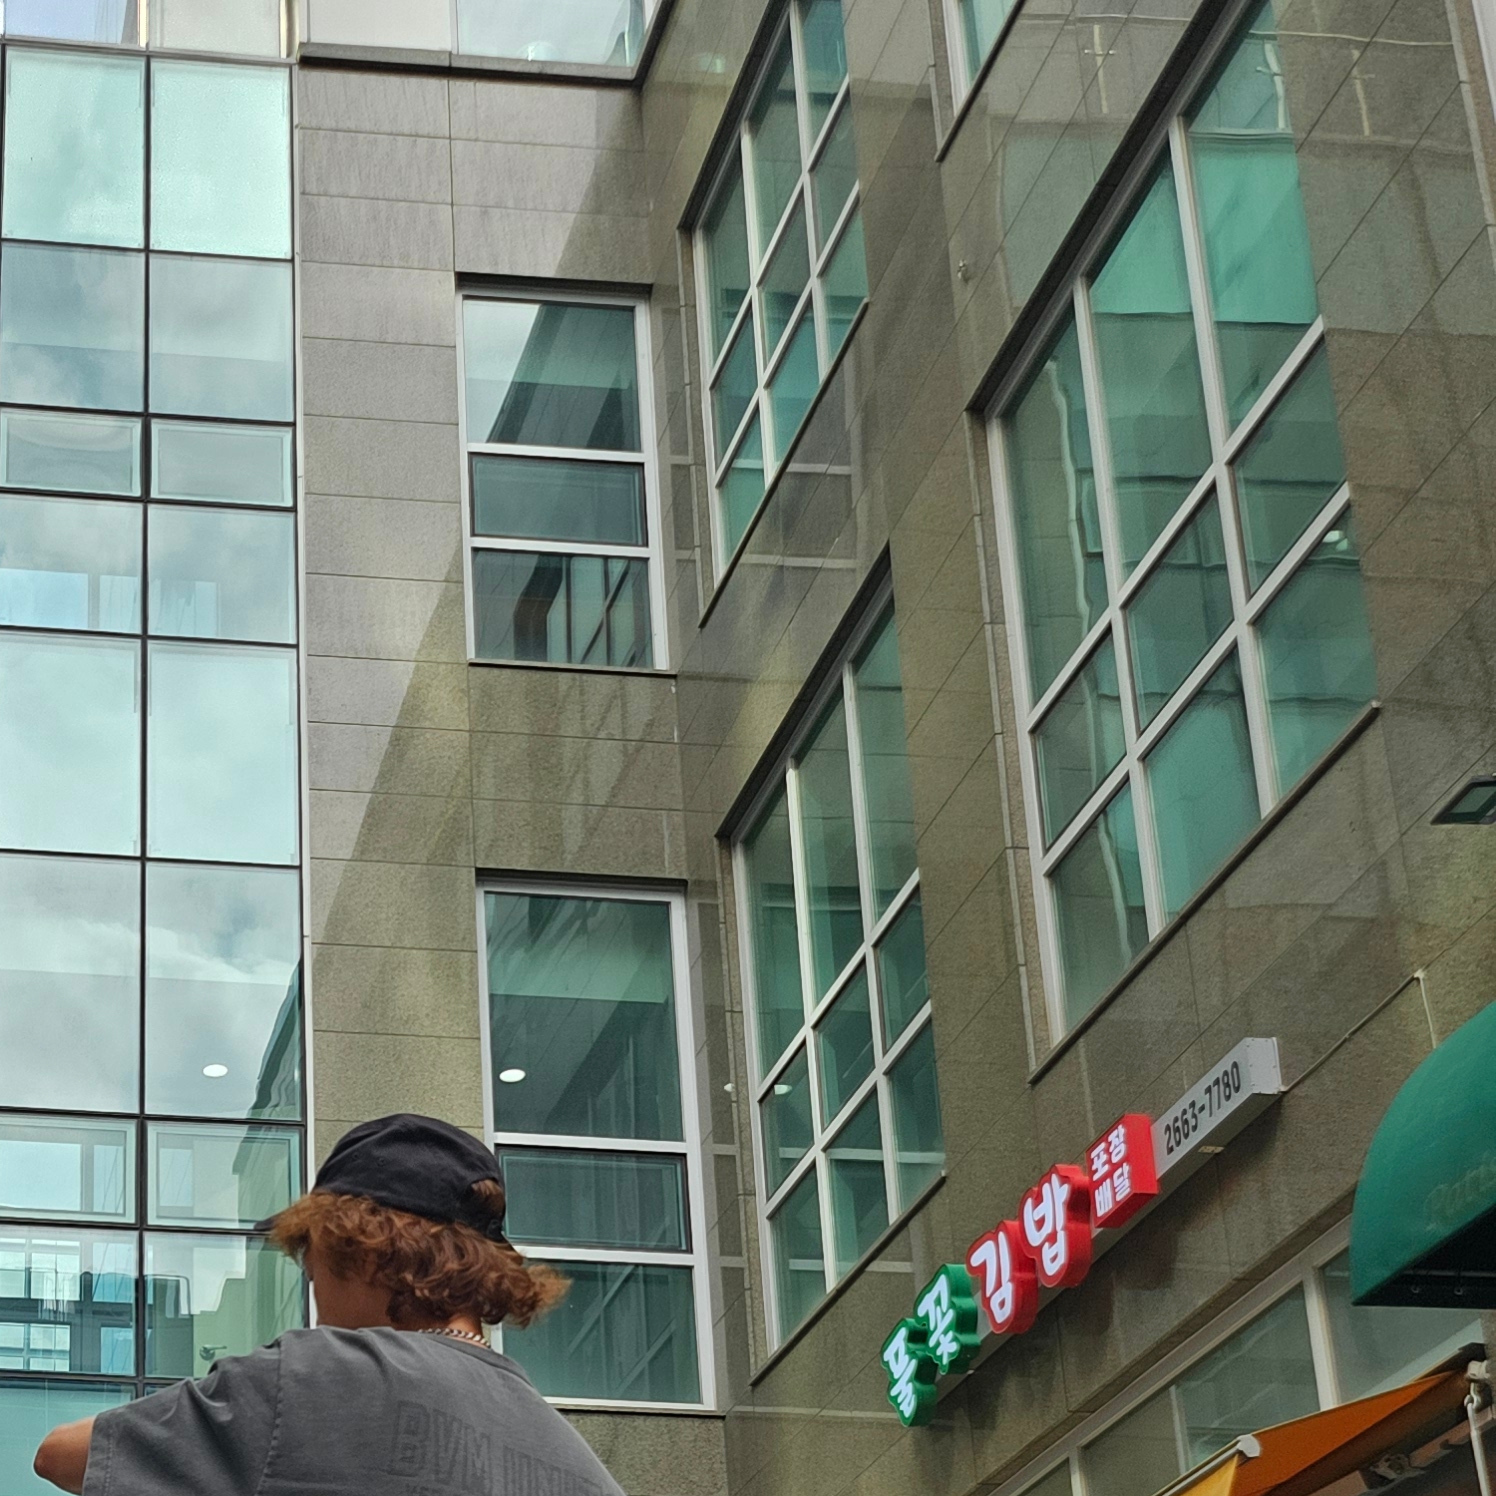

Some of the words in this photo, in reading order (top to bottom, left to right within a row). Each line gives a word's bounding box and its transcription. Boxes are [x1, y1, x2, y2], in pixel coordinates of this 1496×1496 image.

[1163, 1059, 1241, 1156] 2663-7780
[1090, 1124, 1127, 1182] 포장
[1094, 1163, 1131, 1218] 배달
